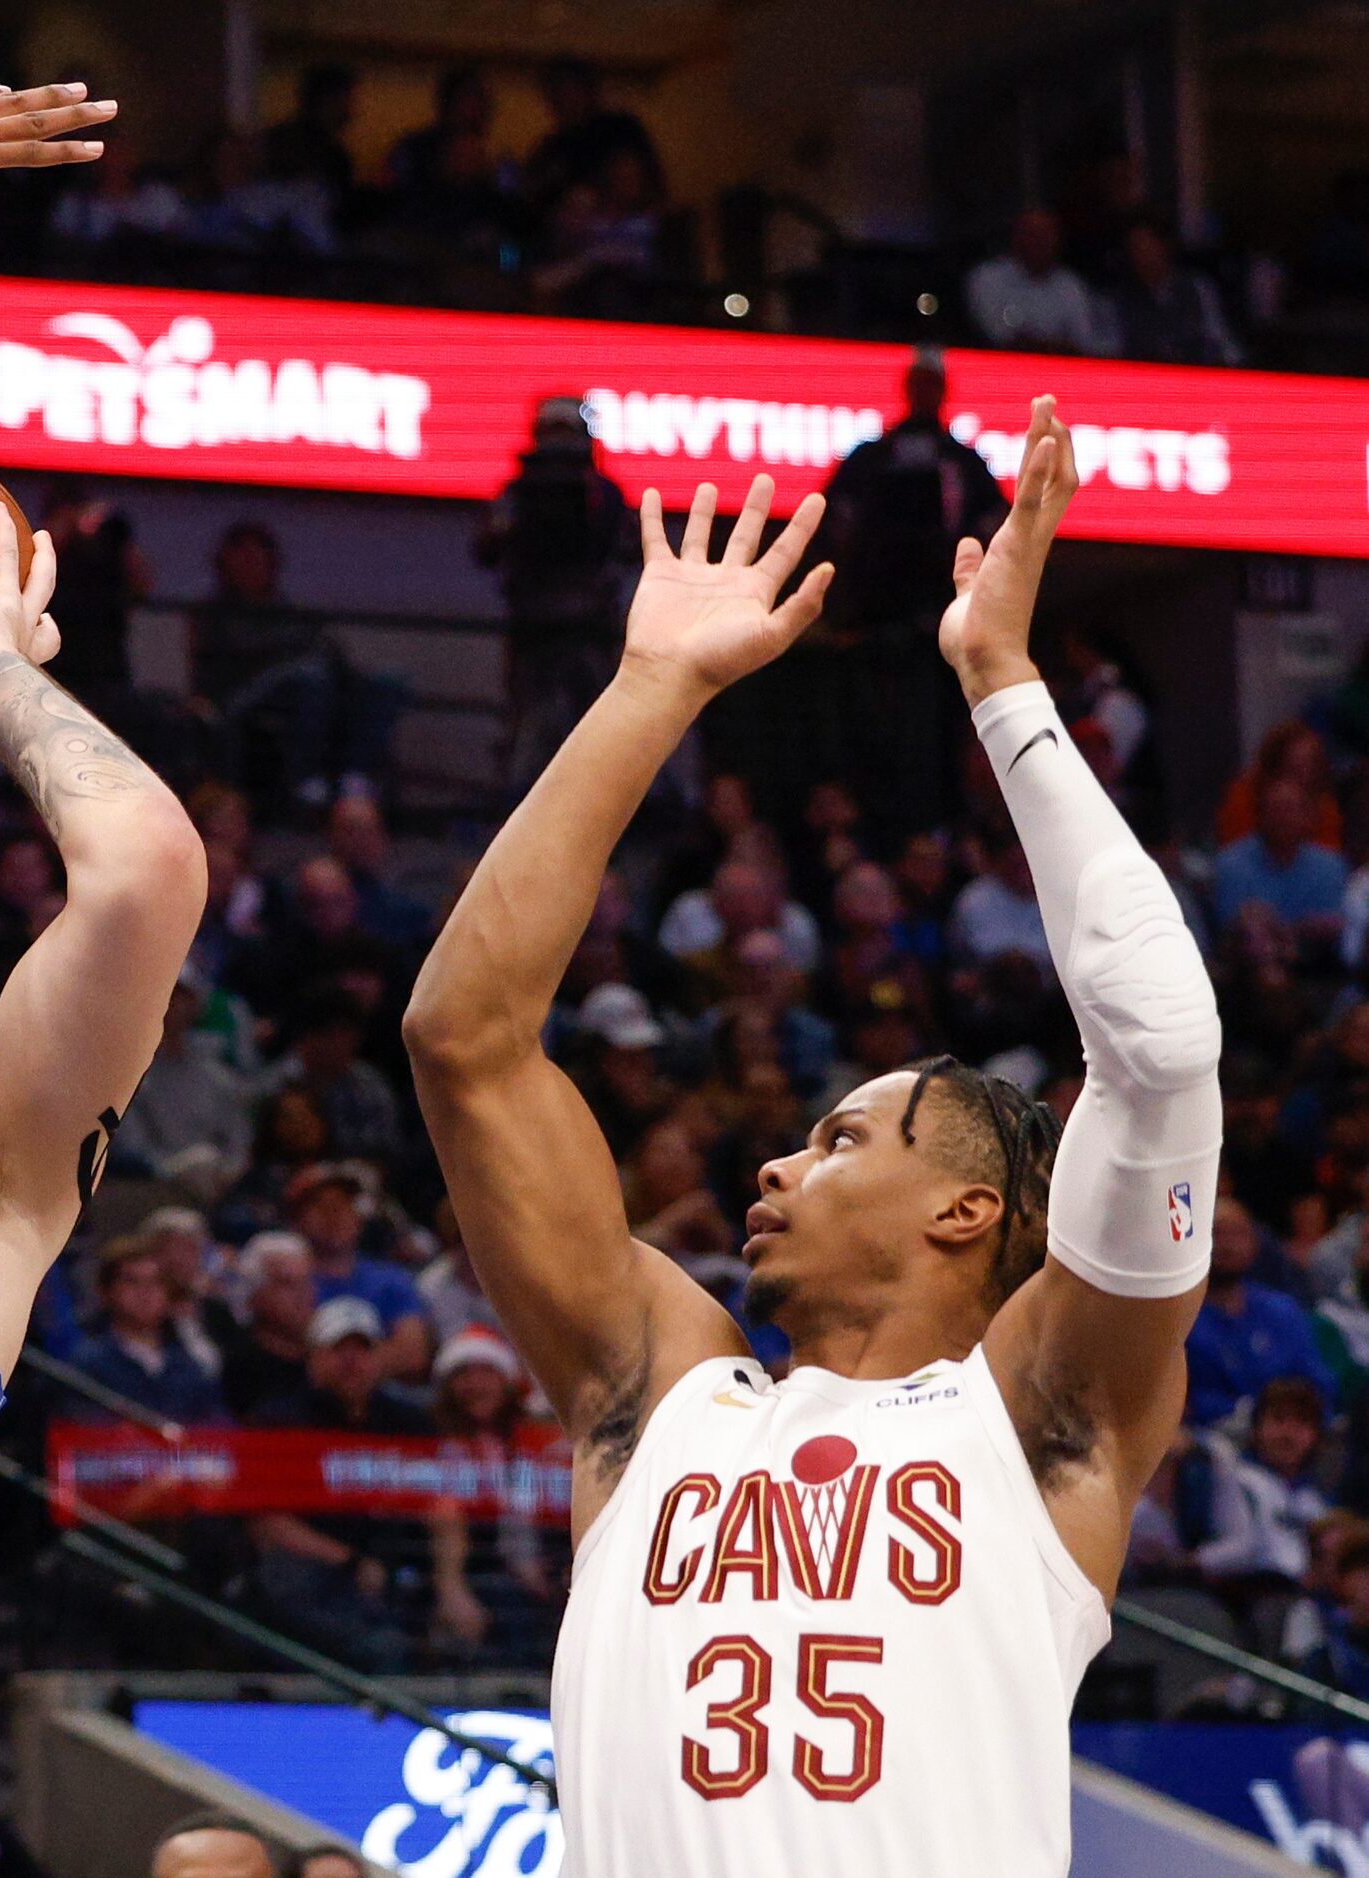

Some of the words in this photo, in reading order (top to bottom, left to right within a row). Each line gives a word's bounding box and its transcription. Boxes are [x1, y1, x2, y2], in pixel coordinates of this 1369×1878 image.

[875, 1386, 959, 1409] CLIFFS
[641, 1459, 962, 1607] CAVS
[681, 1632, 885, 1803] 35
